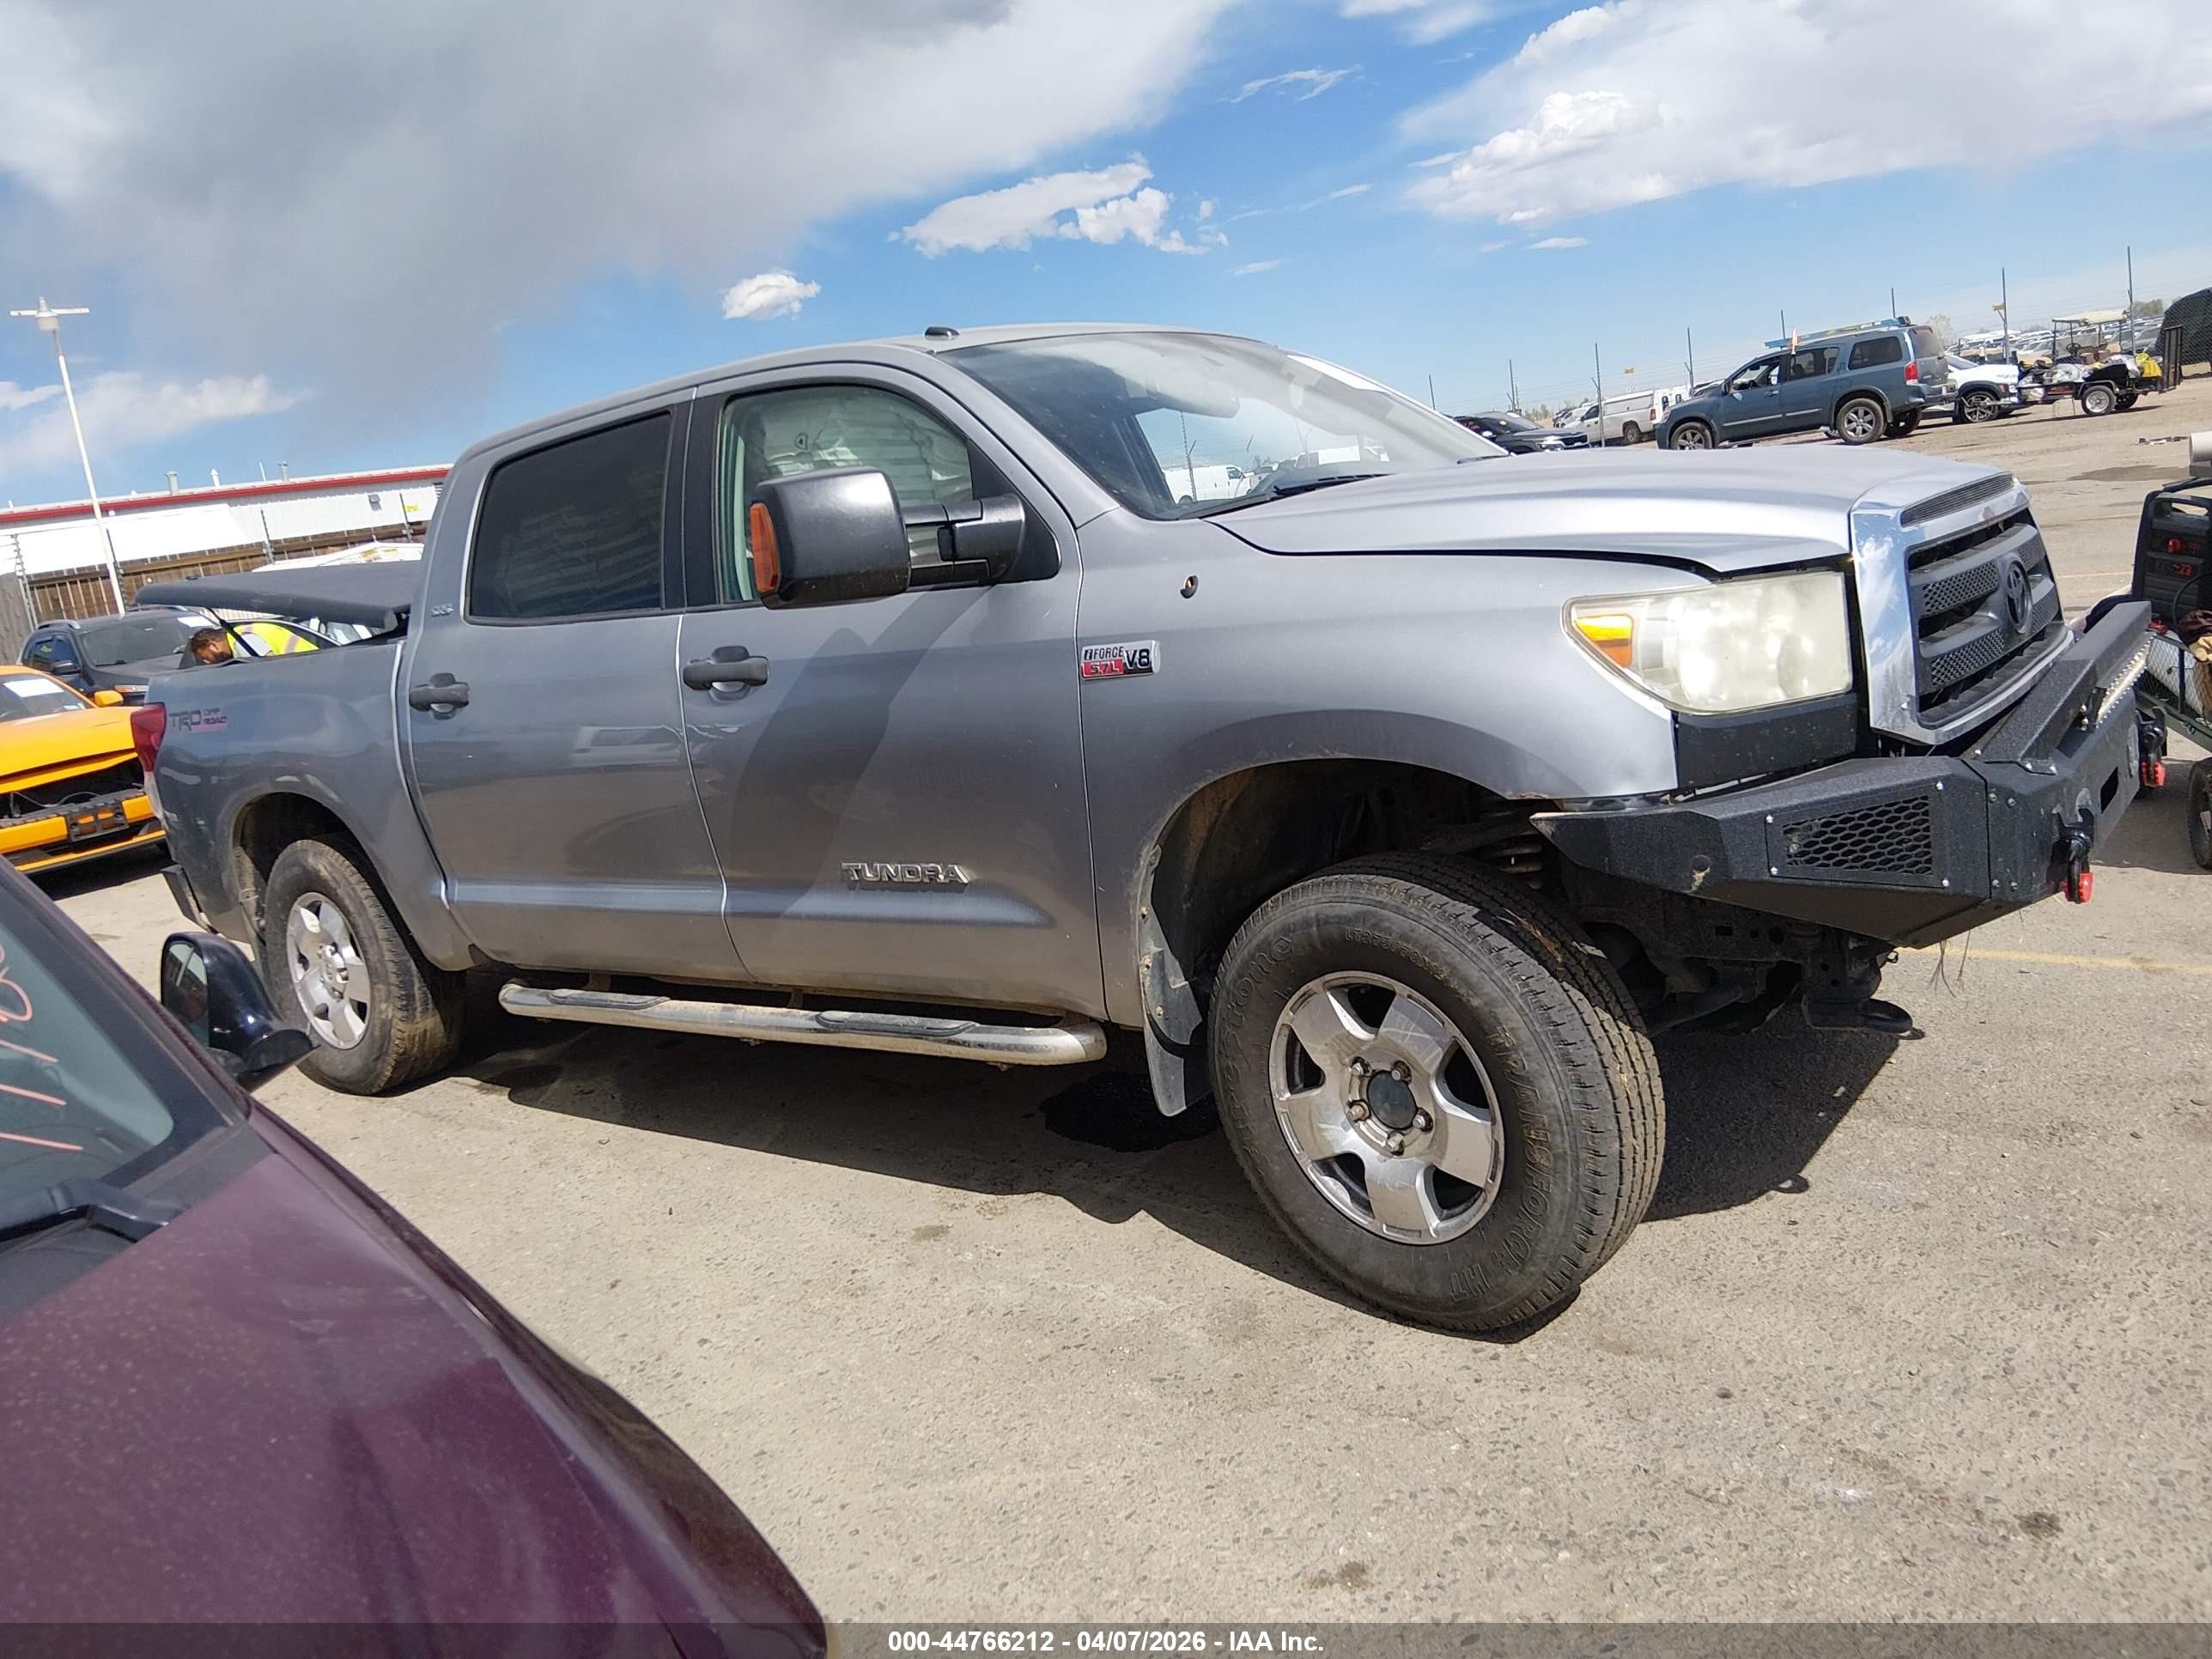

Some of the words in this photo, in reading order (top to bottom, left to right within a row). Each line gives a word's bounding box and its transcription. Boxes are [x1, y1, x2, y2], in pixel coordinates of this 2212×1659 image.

[1125, 647, 1152, 670] V8
[169, 709, 202, 732] TRD
[841, 862, 970, 884] TUNDRA
